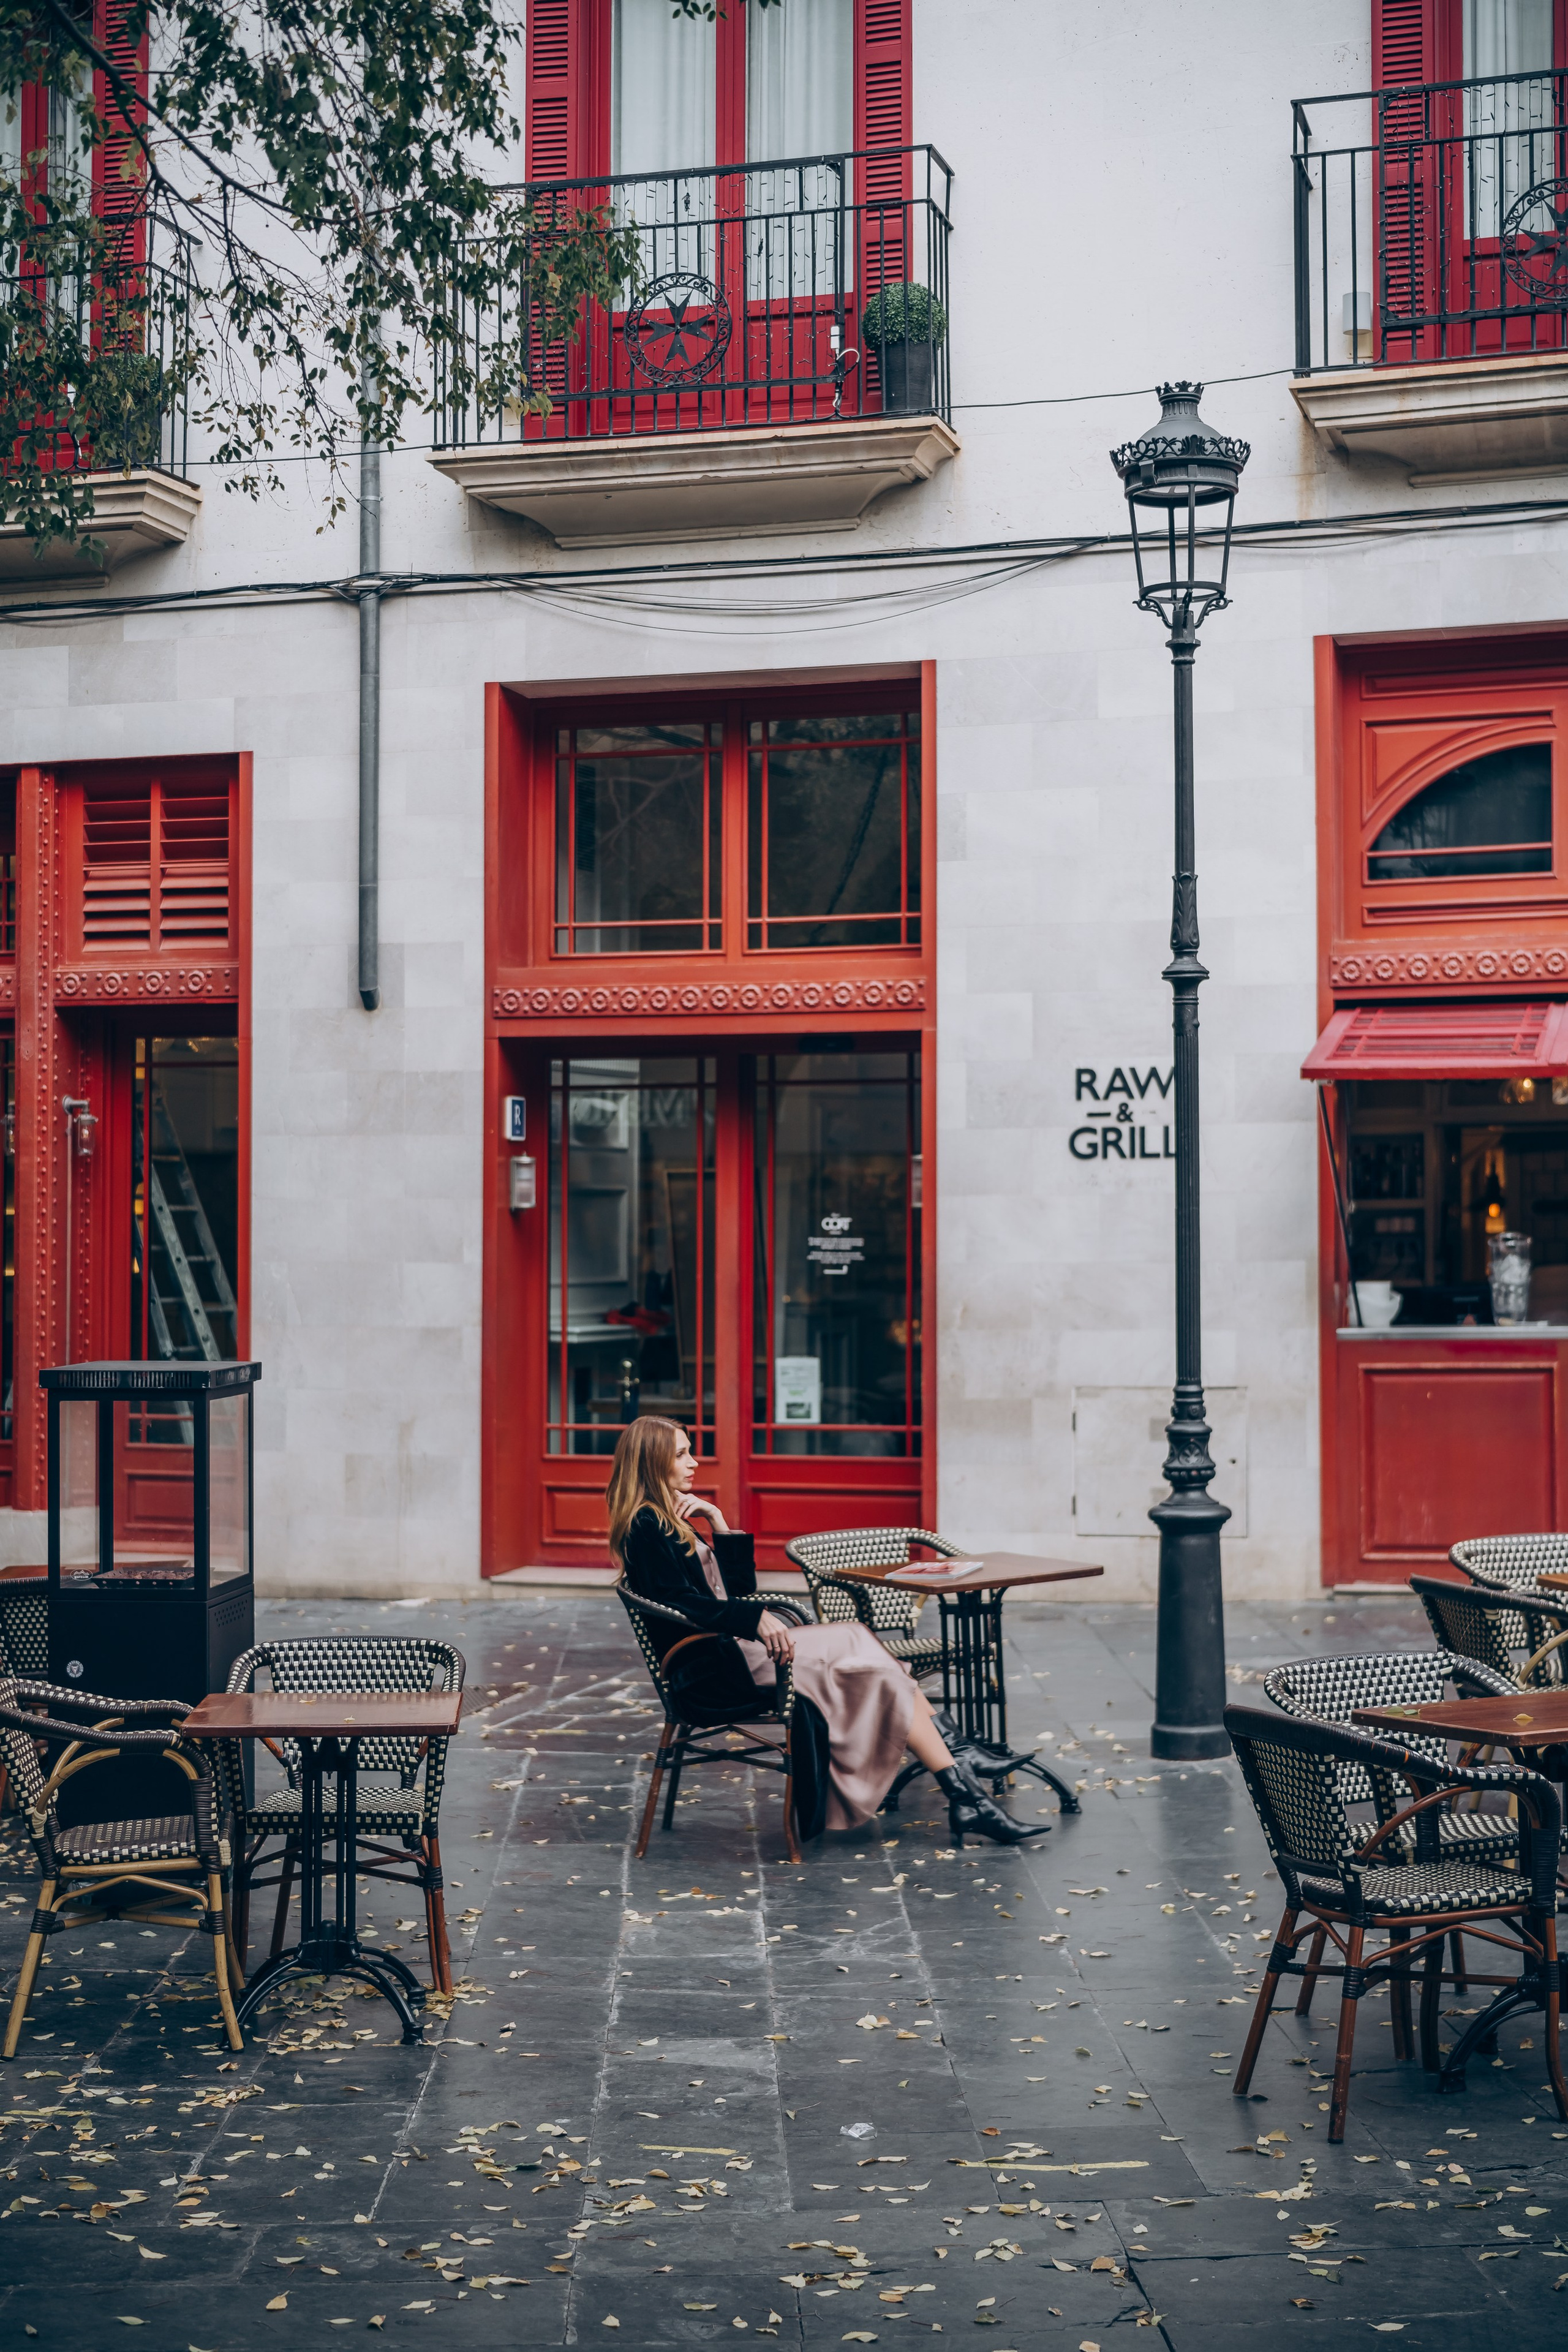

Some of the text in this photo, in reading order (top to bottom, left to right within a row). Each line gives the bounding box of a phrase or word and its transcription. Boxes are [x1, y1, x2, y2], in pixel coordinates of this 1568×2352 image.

[1076, 1066, 1175, 1101] RAW
[1116, 1102, 1133, 1123] &
[1069, 1125, 1177, 1160] GRILL
